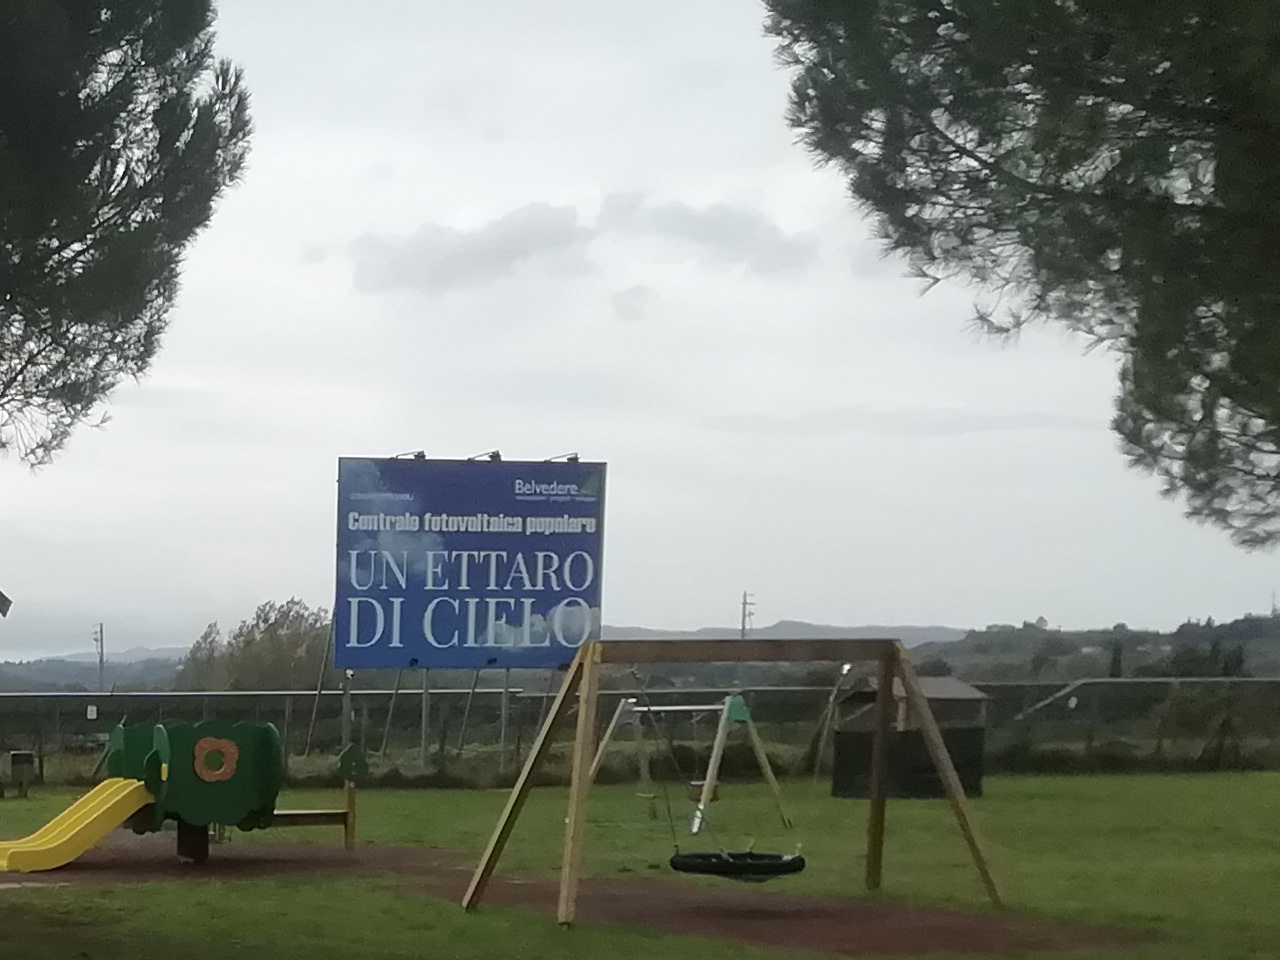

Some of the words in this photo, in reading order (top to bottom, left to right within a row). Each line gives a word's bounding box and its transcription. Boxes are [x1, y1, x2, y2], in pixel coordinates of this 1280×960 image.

[514, 479, 580, 494] Belvedere
[424, 513, 522, 532] fotovoltaica
[348, 550, 407, 590] UN
[424, 551, 594, 591] ETTARO
[346, 597, 405, 648] DI
[423, 597, 591, 648] CIELO
